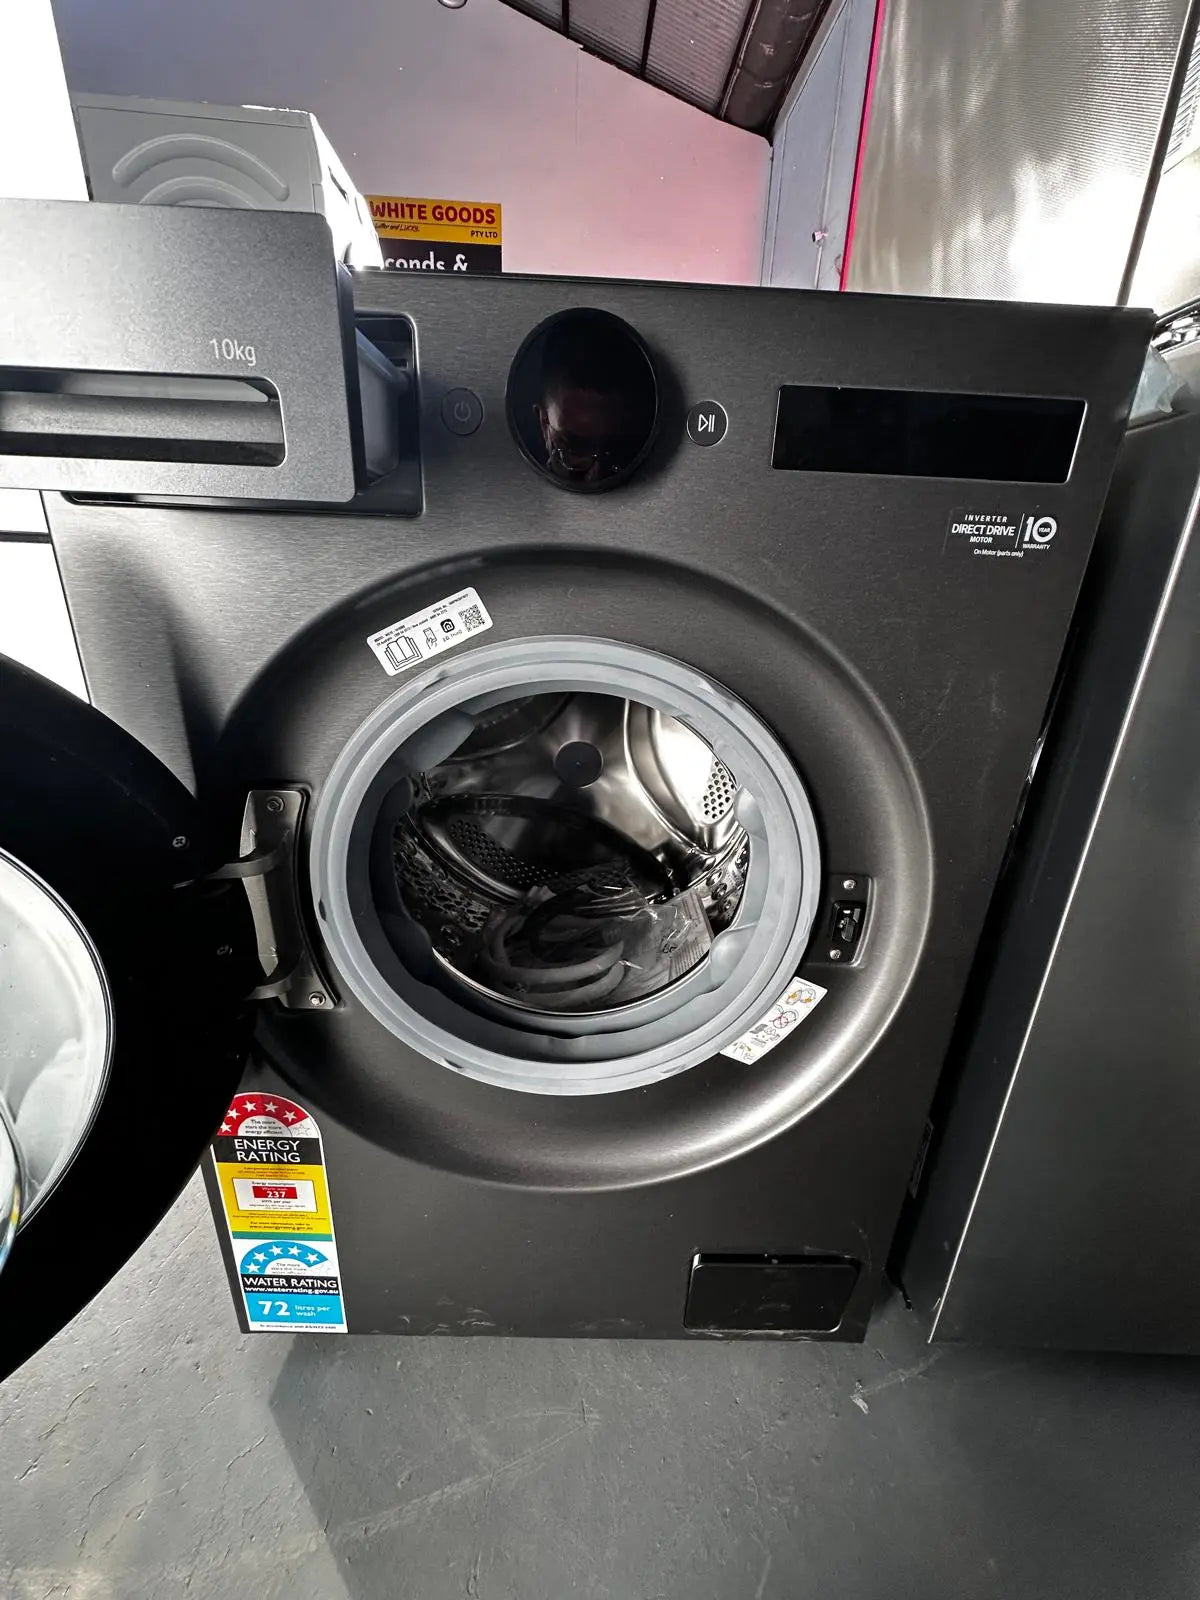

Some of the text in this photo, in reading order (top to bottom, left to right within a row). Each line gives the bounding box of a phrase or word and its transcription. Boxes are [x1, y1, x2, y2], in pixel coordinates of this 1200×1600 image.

[370, 200, 496, 224] WHITE GOODS
[471, 230, 498, 239] PTY LTD
[384, 251, 468, 271] conds &
[210, 338, 256, 366] 10kg
[964, 514, 1008, 523] INVERTER
[951, 523, 1017, 536] DIRECT DRIVE
[1023, 516, 1058, 543] 10
[969, 536, 993, 544] MOTOR
[234, 1138, 300, 1151] ENERGY
[236, 1151, 301, 1163] RATING
[266, 1190, 286, 1198] 237
[243, 1276, 338, 1288] WATER RATING
[245, 1287, 339, 1295] www.waterrating.gov.au
[258, 1300, 291, 1316] 72
